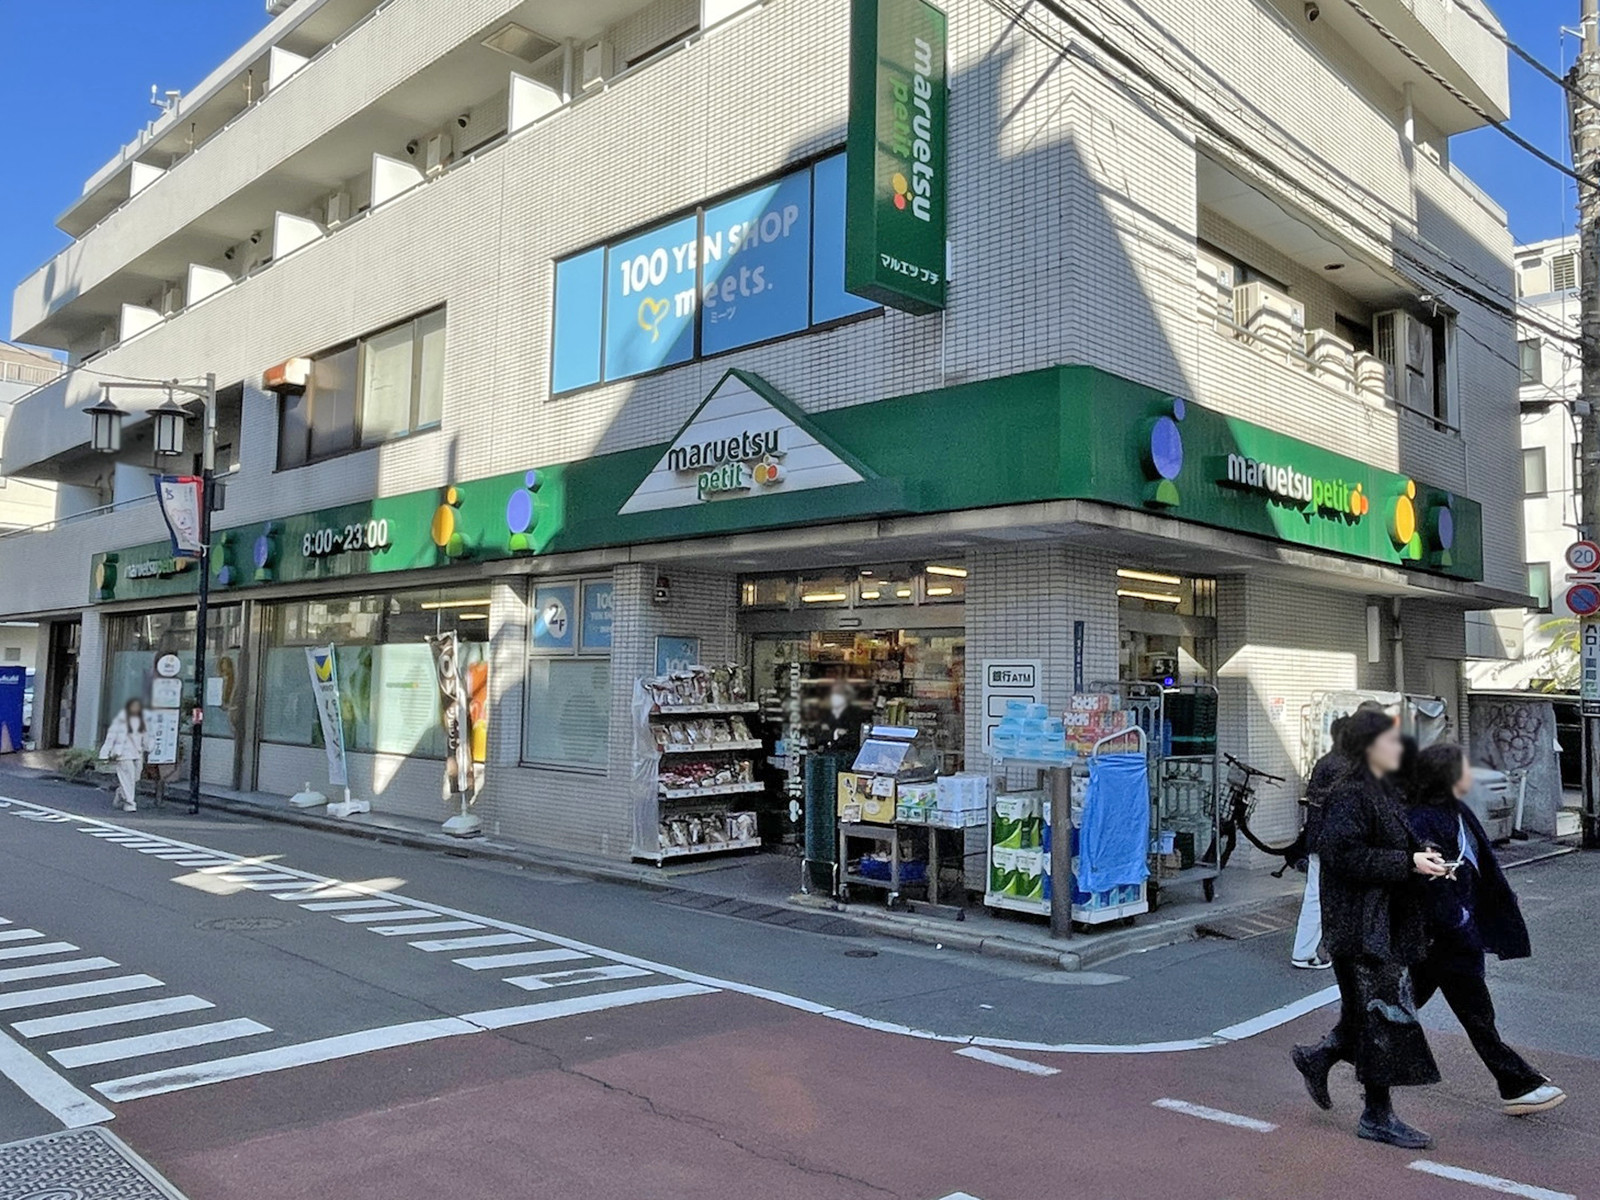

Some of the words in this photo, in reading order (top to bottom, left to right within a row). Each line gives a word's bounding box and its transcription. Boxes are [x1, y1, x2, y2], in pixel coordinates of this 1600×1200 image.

[889, 76, 912, 158] petit
[913, 37, 933, 222] maruetsu
[621, 248, 668, 296] 100
[672, 231, 722, 274] YEN
[728, 205, 798, 255] SHOP
[880, 253, 919, 277] マルエツ
[674, 265, 773, 318] meets.
[710, 306, 736, 323] ミーツ
[668, 430, 778, 470] maruetsu
[697, 463, 742, 500] petit
[1228, 453, 1312, 501] maruetsu
[1313, 478, 1350, 513] petit
[1574, 549, 1593, 564] 20
[548, 603, 566, 632] 2F
[992, 670, 1031, 683] 銀行ATM
